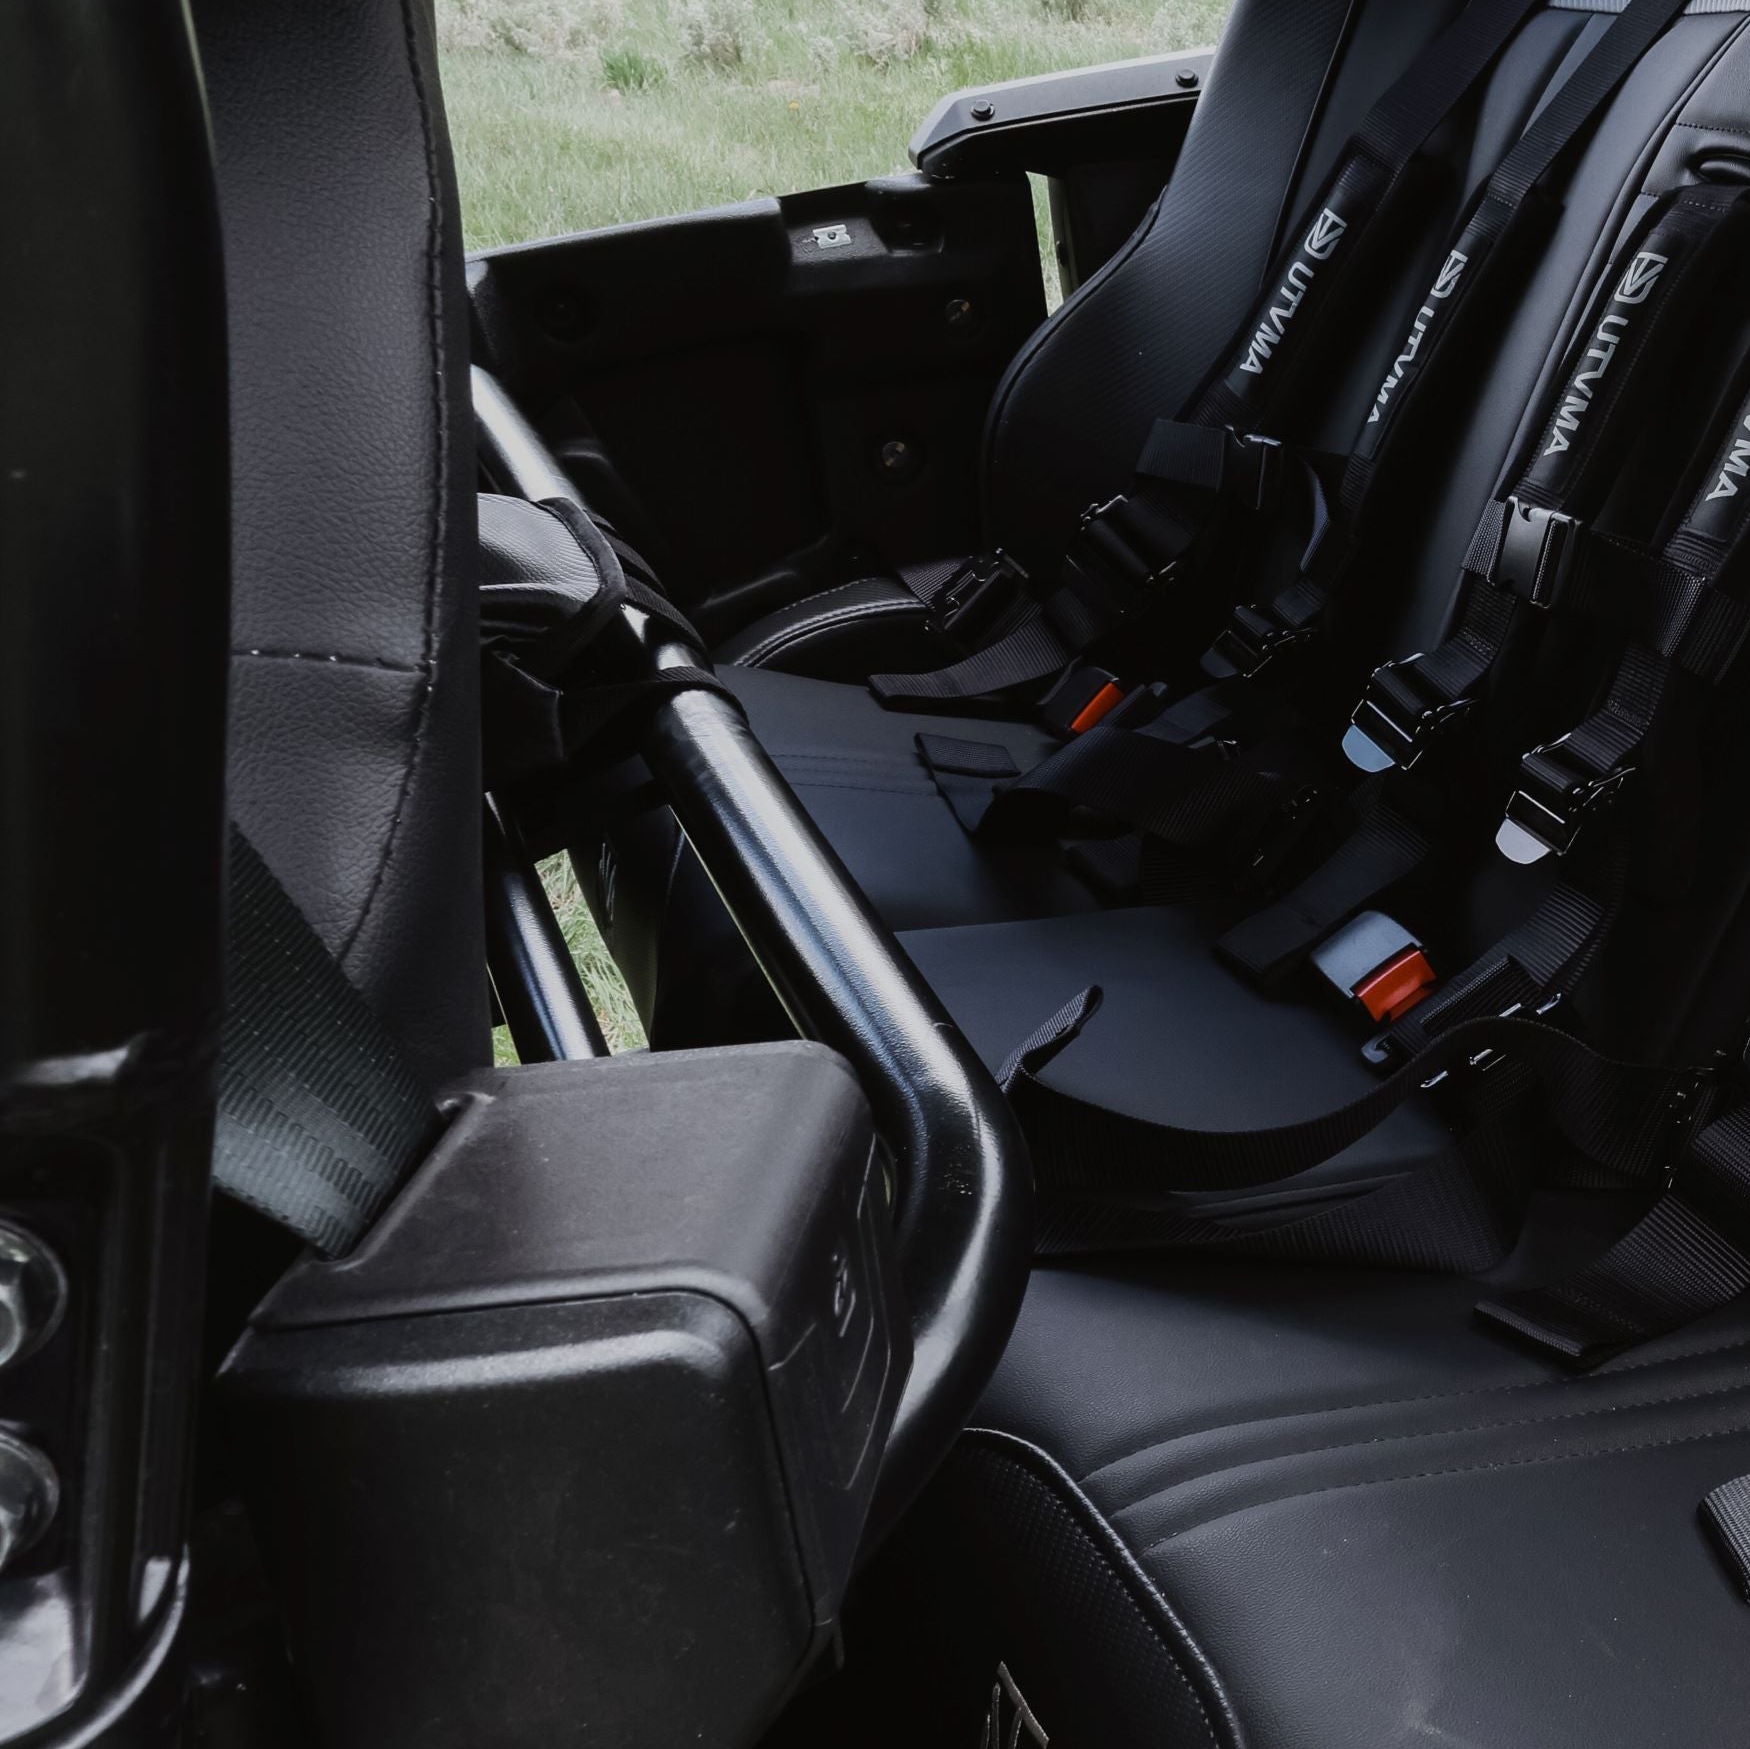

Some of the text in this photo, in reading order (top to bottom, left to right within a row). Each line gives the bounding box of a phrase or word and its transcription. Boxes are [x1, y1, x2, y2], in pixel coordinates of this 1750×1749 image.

[1239, 260, 1314, 375] UTVMA
[1367, 305, 1435, 423] UTVMA
[1544, 314, 1630, 457] UTVMA
